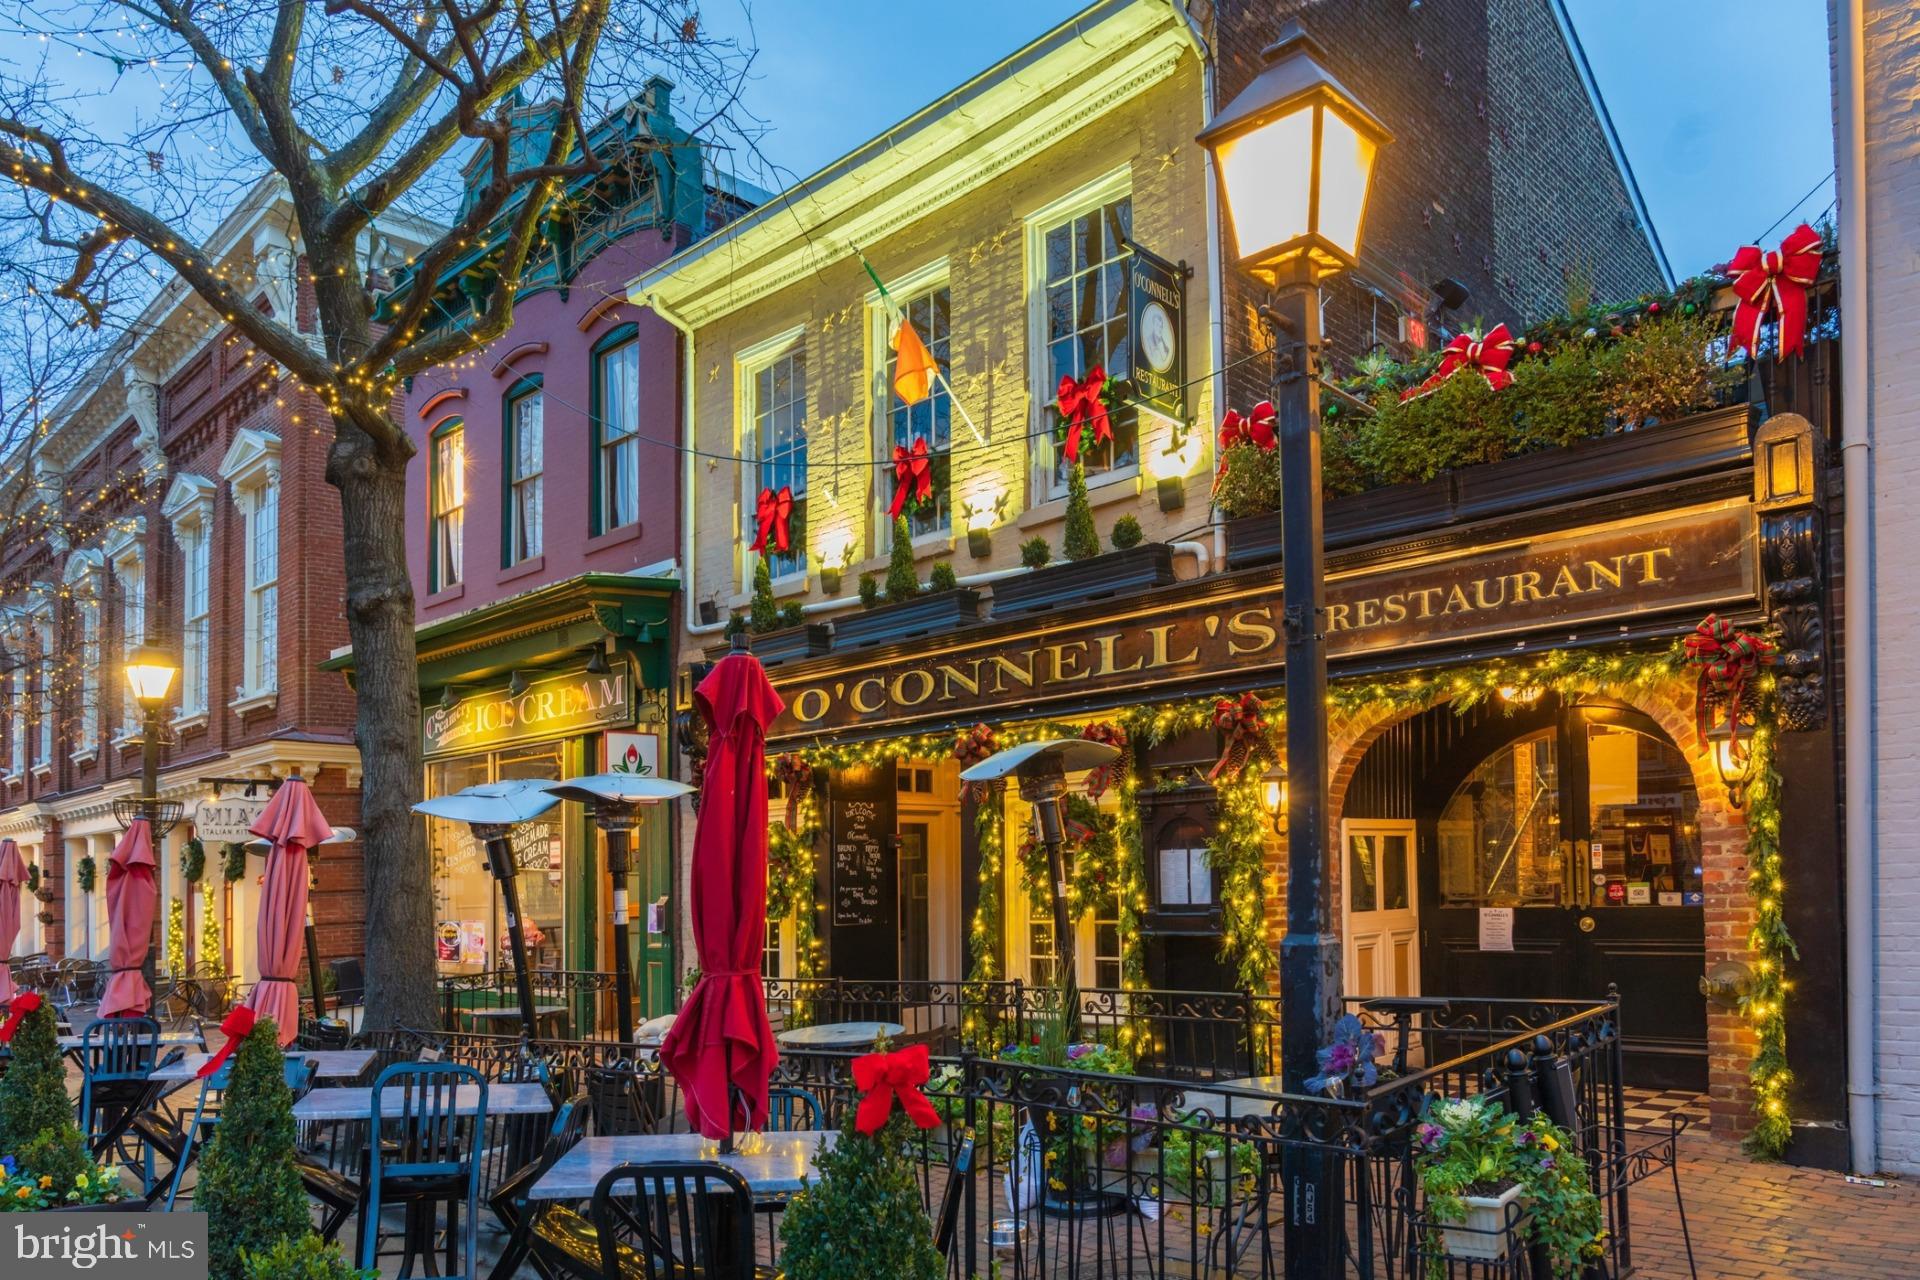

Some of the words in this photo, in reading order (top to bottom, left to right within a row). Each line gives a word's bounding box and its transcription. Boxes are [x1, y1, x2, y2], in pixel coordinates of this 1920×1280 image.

[1135, 272, 1179, 309] O'CONNELL'S
[1135, 367, 1179, 397] RESTAURANT
[793, 607, 1277, 722] O'CONNELL'S
[1325, 547, 1671, 633] RESTAURANT
[475, 702, 515, 733] ICE
[519, 675, 625, 725] CREAM
[845, 808, 876, 820] WELCOME
[523, 840, 549, 862] CREAM
